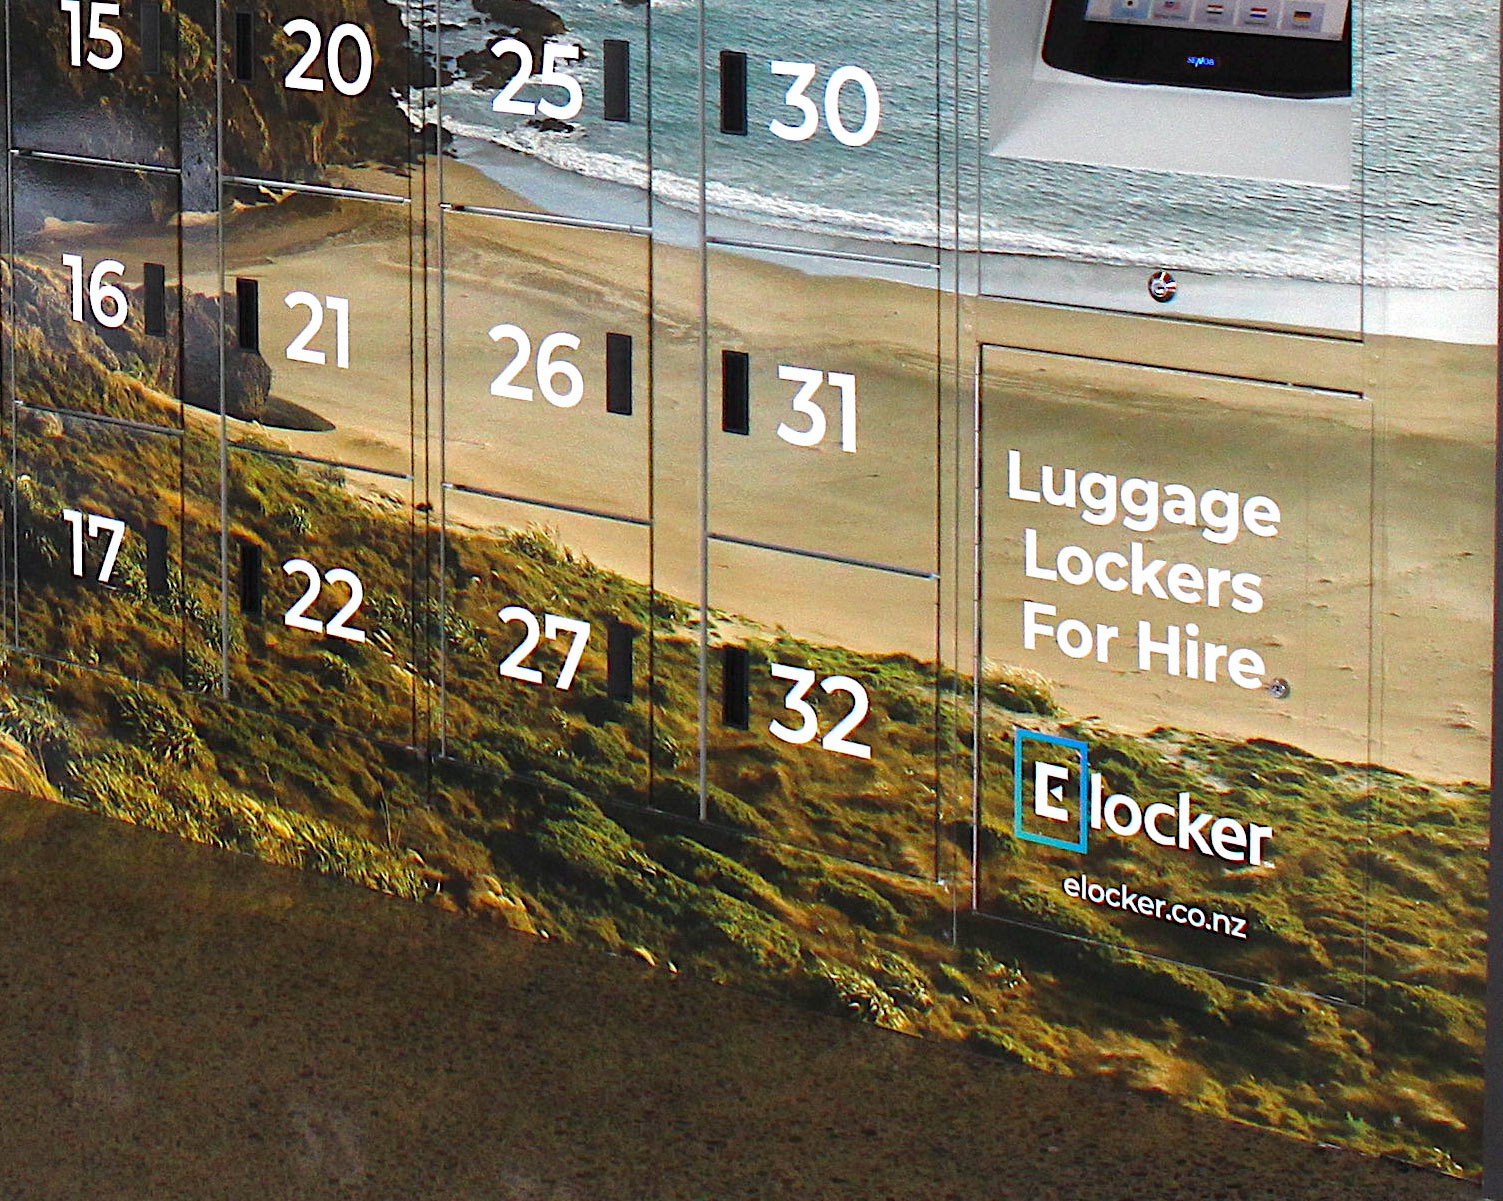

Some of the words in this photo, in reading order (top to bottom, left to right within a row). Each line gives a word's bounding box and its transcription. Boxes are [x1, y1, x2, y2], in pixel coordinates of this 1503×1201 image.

[284, 19, 372, 96] 20
[491, 36, 583, 120] 25
[769, 60, 881, 147] 30
[61, 253, 128, 329] 16
[284, 290, 350, 369] 21
[489, 322, 585, 408] 26
[776, 363, 858, 453] 31
[1007, 449, 1281, 545] Luggage
[62, 508, 125, 584] 17
[1024, 528, 1264, 614] Lockers
[283, 559, 367, 642] 22
[498, 605, 591, 691] 27
[1023, 600, 1119, 664] For
[1138, 620, 1266, 691] Hire
[768, 662, 873, 759] 32
[1063, 874, 1248, 940] elocker.co.nz
